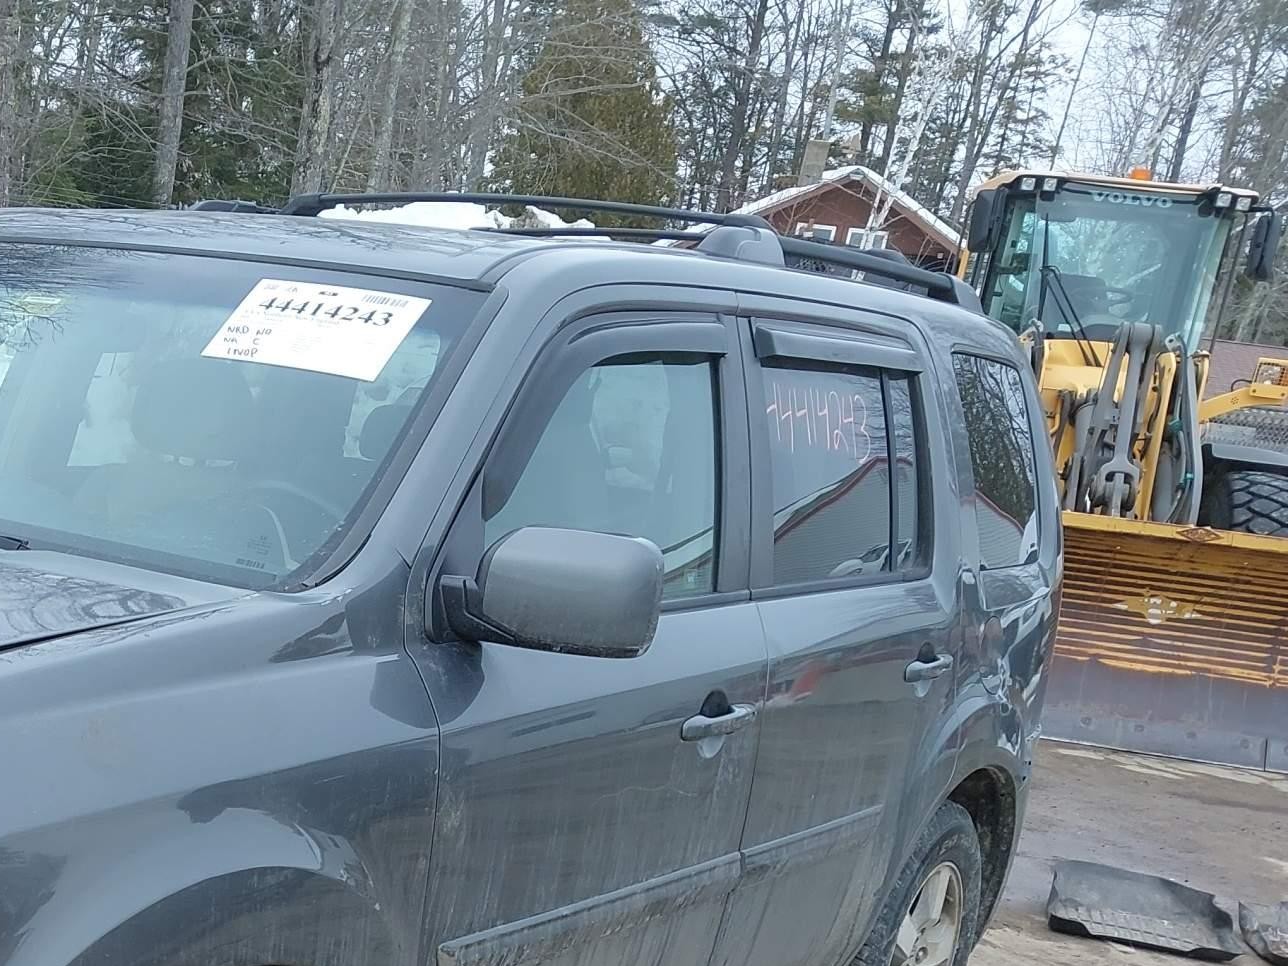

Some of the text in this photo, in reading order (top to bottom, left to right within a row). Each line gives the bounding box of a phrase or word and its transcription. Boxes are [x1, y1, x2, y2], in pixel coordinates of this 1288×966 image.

[1090, 190, 1173, 208] VOLVO
[258, 296, 394, 327] 44414243
[766, 382, 872, 464] 44414243
